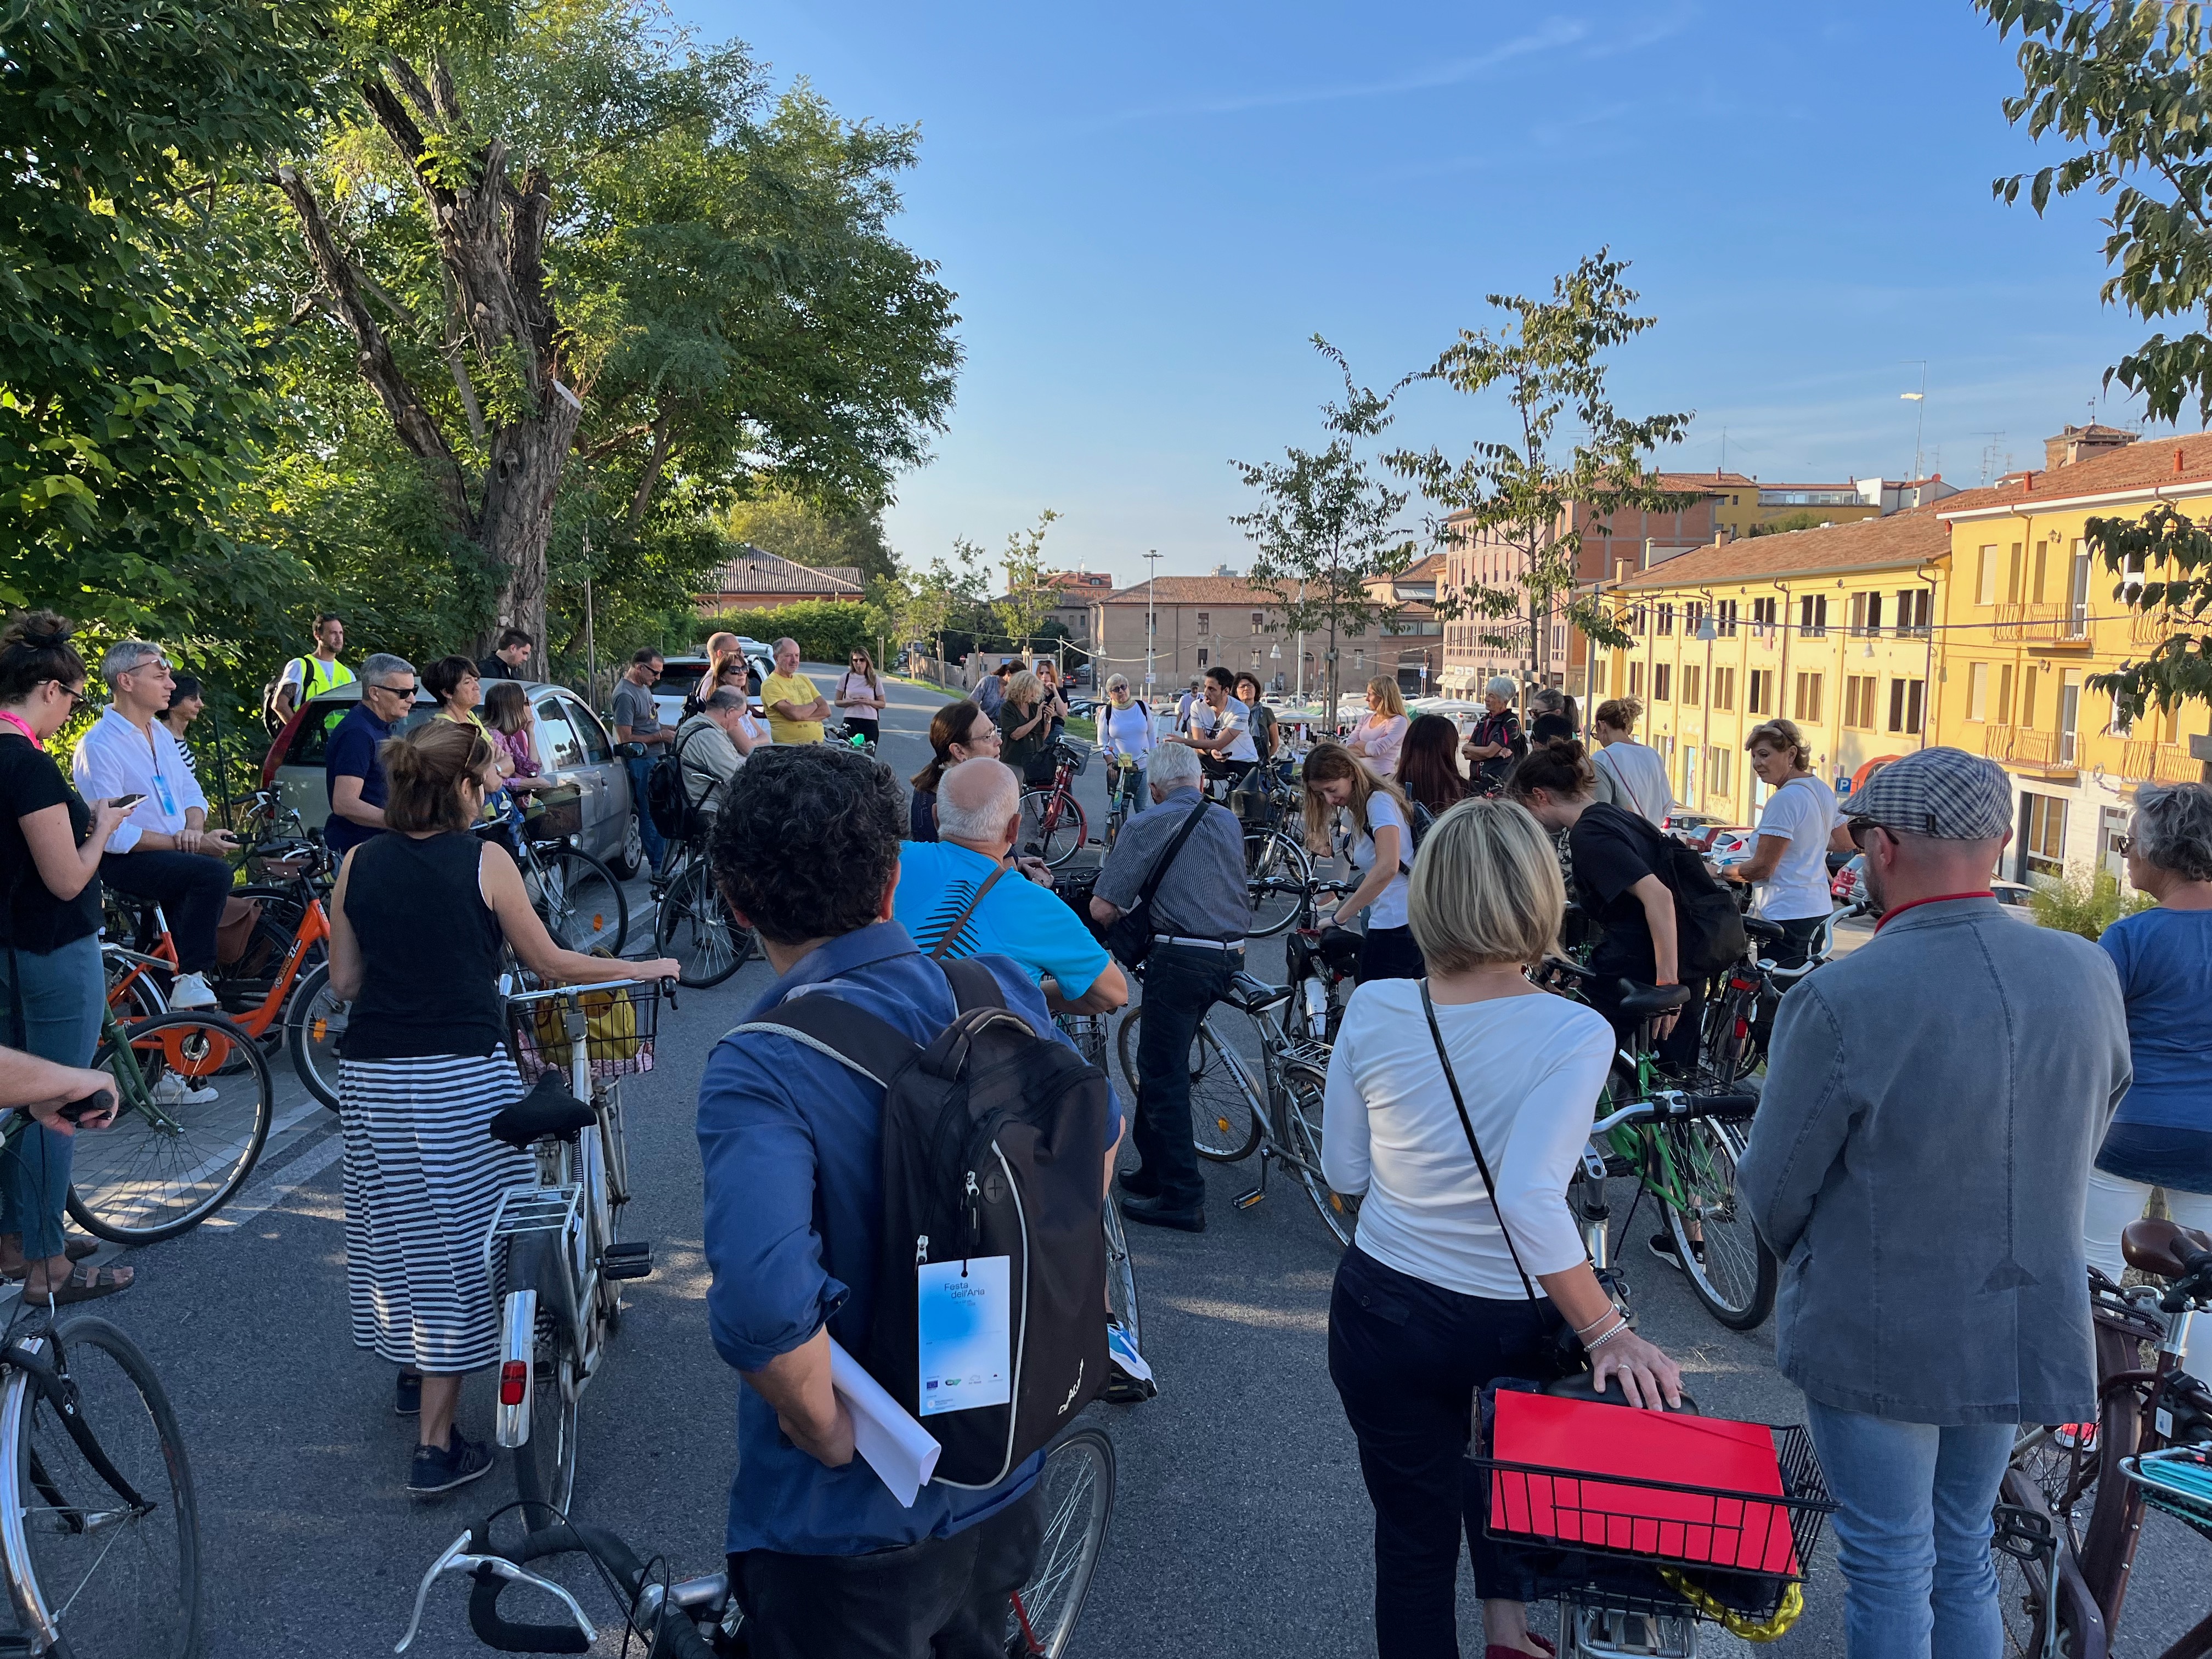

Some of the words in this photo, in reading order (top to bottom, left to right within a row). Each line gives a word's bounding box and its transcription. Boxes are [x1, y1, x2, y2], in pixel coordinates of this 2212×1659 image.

[1839, 780, 1849, 790] P
[944, 1282, 968, 1291] Festa
[951, 1288, 985, 1299] dell'Aria
